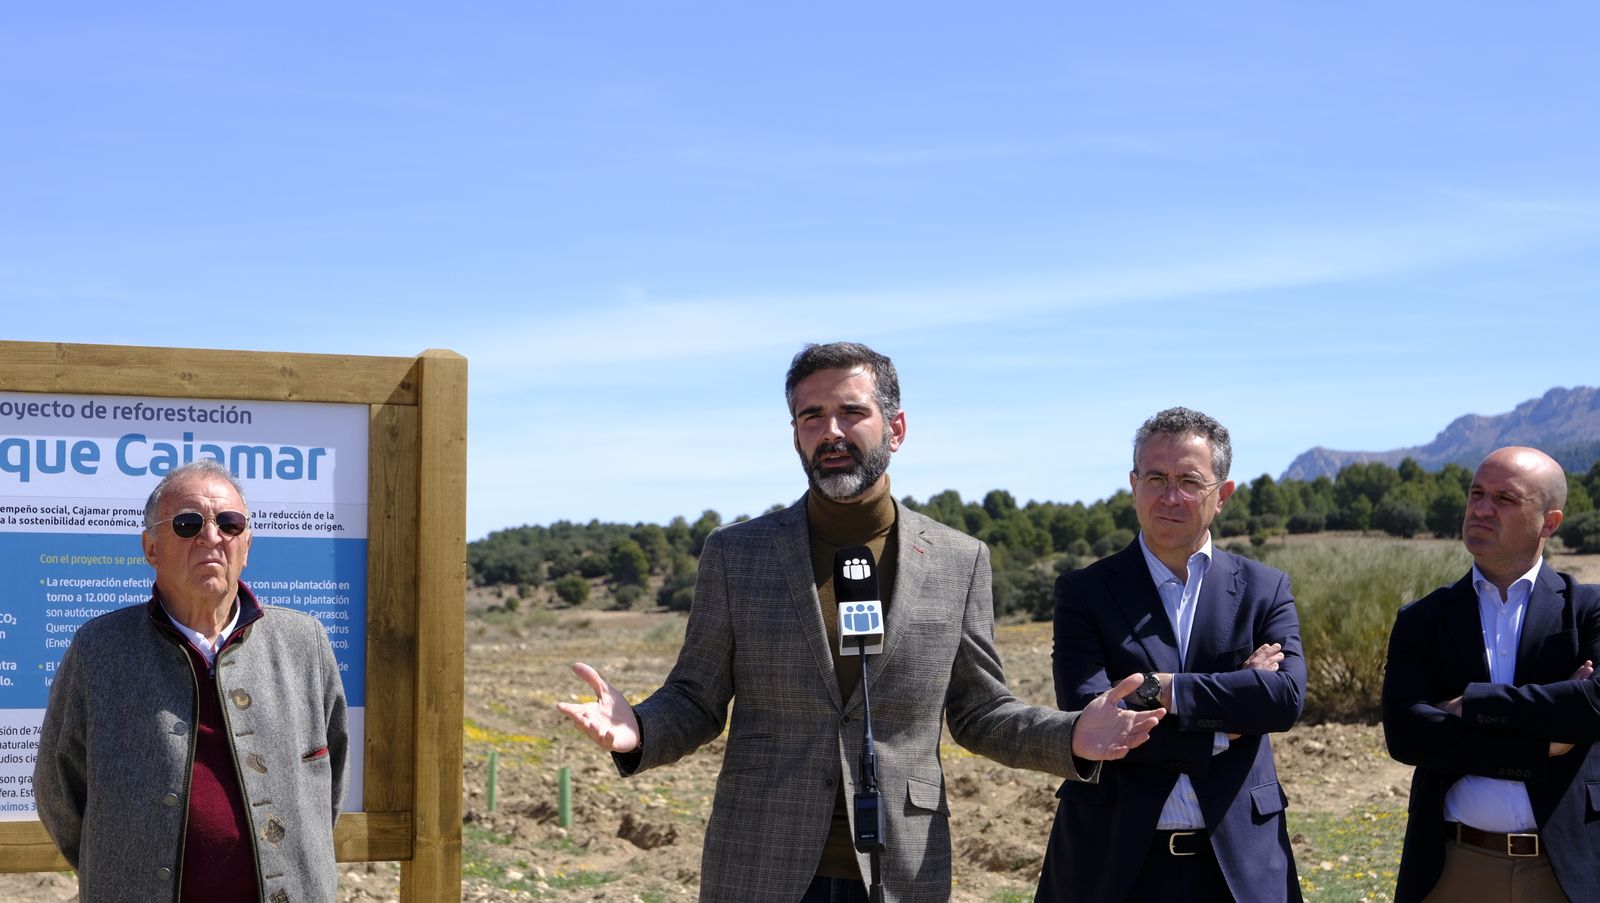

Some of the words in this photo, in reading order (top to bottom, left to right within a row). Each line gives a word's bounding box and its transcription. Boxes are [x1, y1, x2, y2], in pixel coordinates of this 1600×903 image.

[81, 401, 107, 420] de
[113, 403, 252, 424] reforestación
[0, 437, 100, 482] que
[0, 505, 38, 516] empeño
[40, 505, 70, 515] social,
[73, 506, 110, 517] Cajamar
[259, 510, 267, 519] la
[269, 511, 312, 520] reducción
[314, 512, 324, 520] de
[326, 512, 335, 520] la
[8, 516, 17, 525] la
[19, 516, 85, 526] sostenibilidad
[88, 517, 139, 528] económica,
[254, 521, 300, 530] territorios
[302, 522, 313, 530] de
[315, 523, 345, 532] origen.
[40, 554, 58, 565] Con
[60, 554, 69, 564] el
[71, 555, 113, 567] proyecto
[115, 557, 126, 565] se
[47, 577, 58, 587] La
[60, 577, 121, 588] recuperación
[253, 581, 270, 590] con
[272, 582, 288, 590] una
[290, 580, 337, 591] plantación
[339, 582, 350, 590] en
[47, 594, 73, 602] torno
[85, 593, 116, 602] 12.000
[271, 597, 291, 605] para
[293, 595, 301, 604] la
[303, 595, 350, 606] plantación
[46, 609, 62, 617] son
[65, 608, 114, 617] autócton
[46, 623, 82, 634] Quercu
[46, 662, 54, 671] El
[20, 726, 31, 736] de
